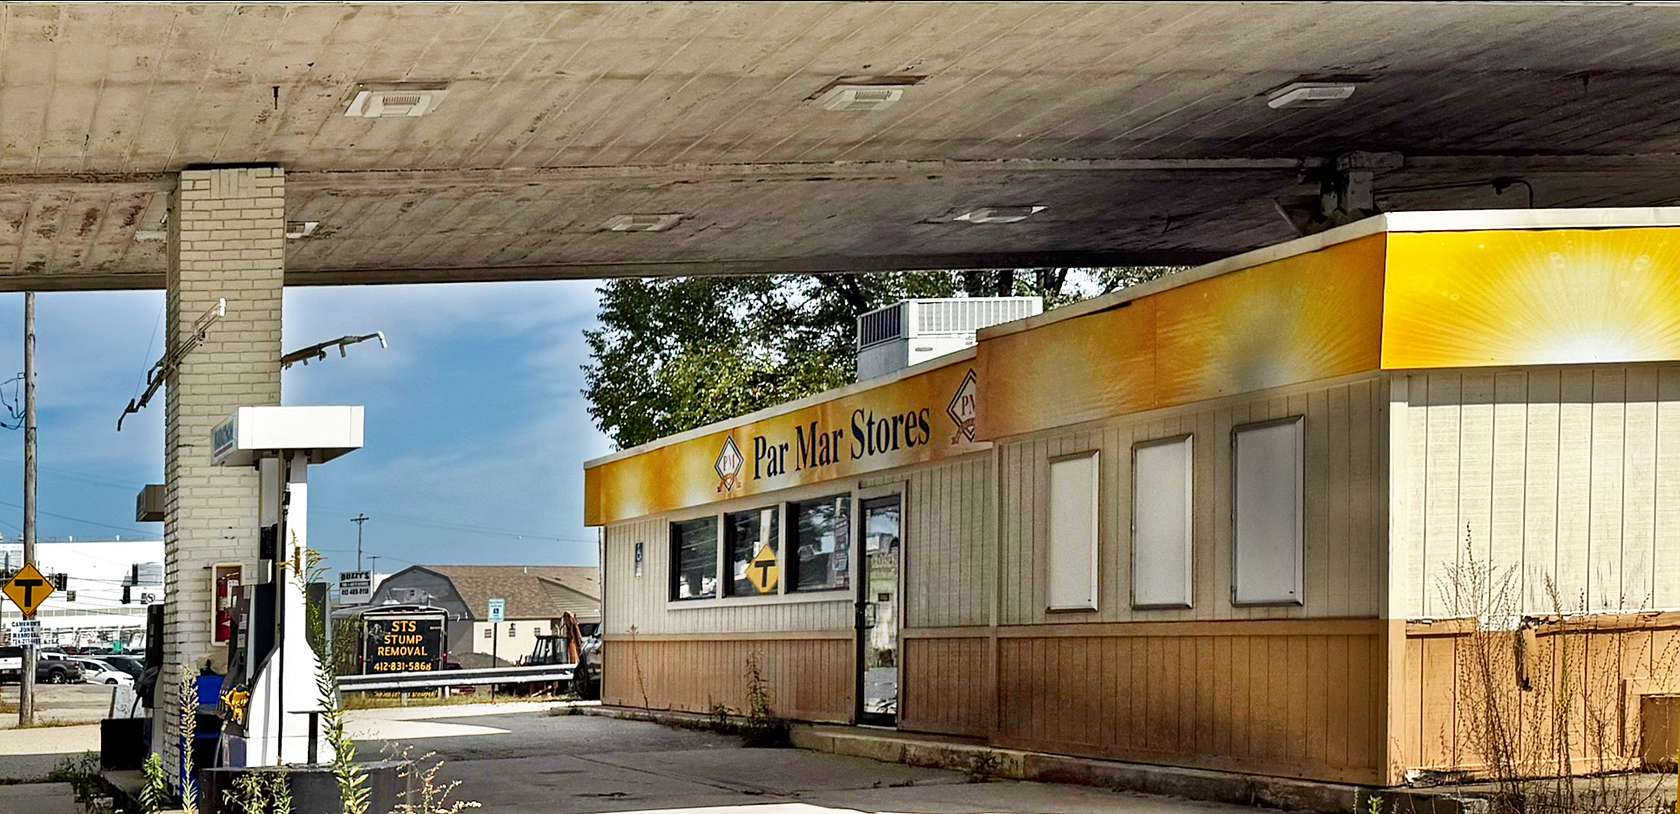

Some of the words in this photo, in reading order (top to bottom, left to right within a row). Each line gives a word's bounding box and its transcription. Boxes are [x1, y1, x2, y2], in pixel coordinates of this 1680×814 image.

[753, 435, 789, 480] Par
[795, 420, 844, 472] Mar
[850, 407, 931, 461] Stores
[391, 620, 417, 632] STS
[383, 634, 423, 645] STUMP
[377, 646, 428, 656] REMOVAL
